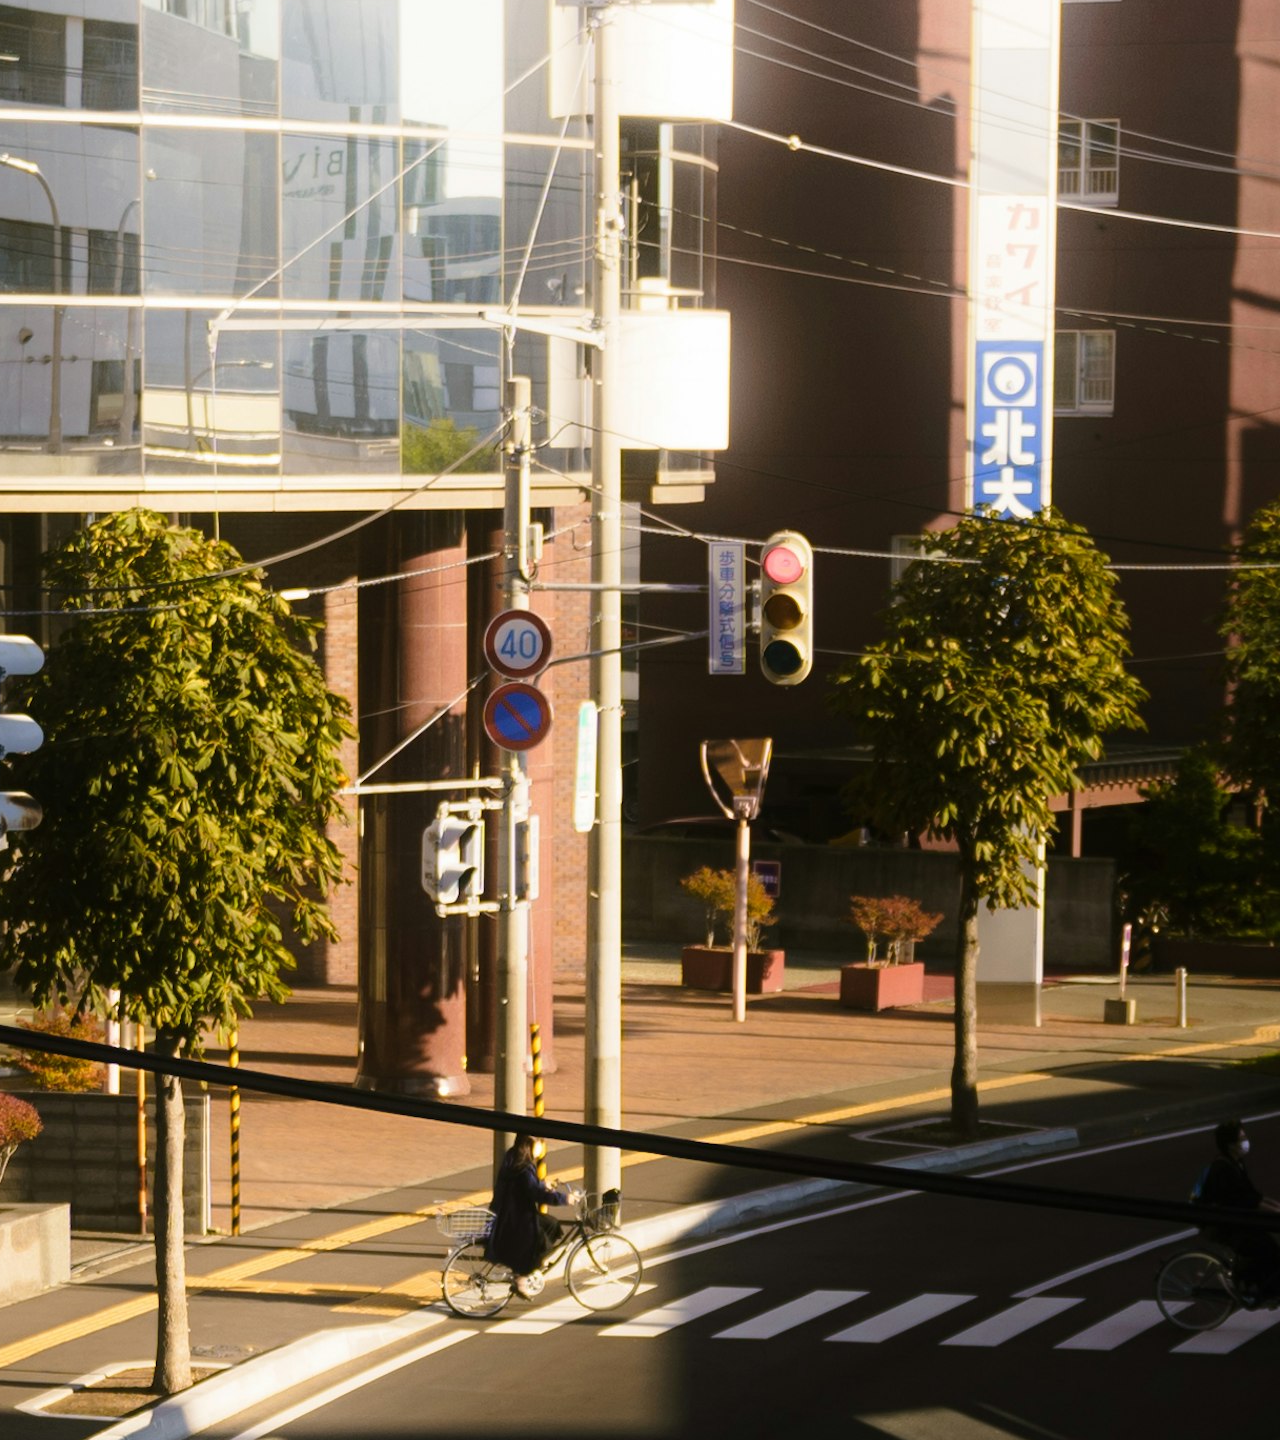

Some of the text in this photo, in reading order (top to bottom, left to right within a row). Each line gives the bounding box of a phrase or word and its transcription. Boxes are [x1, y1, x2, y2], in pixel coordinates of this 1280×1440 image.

[1005, 203, 1040, 306] カワイ
[500, 628, 537, 659] 40
[719, 551, 736, 667] 歩車分離式信号
